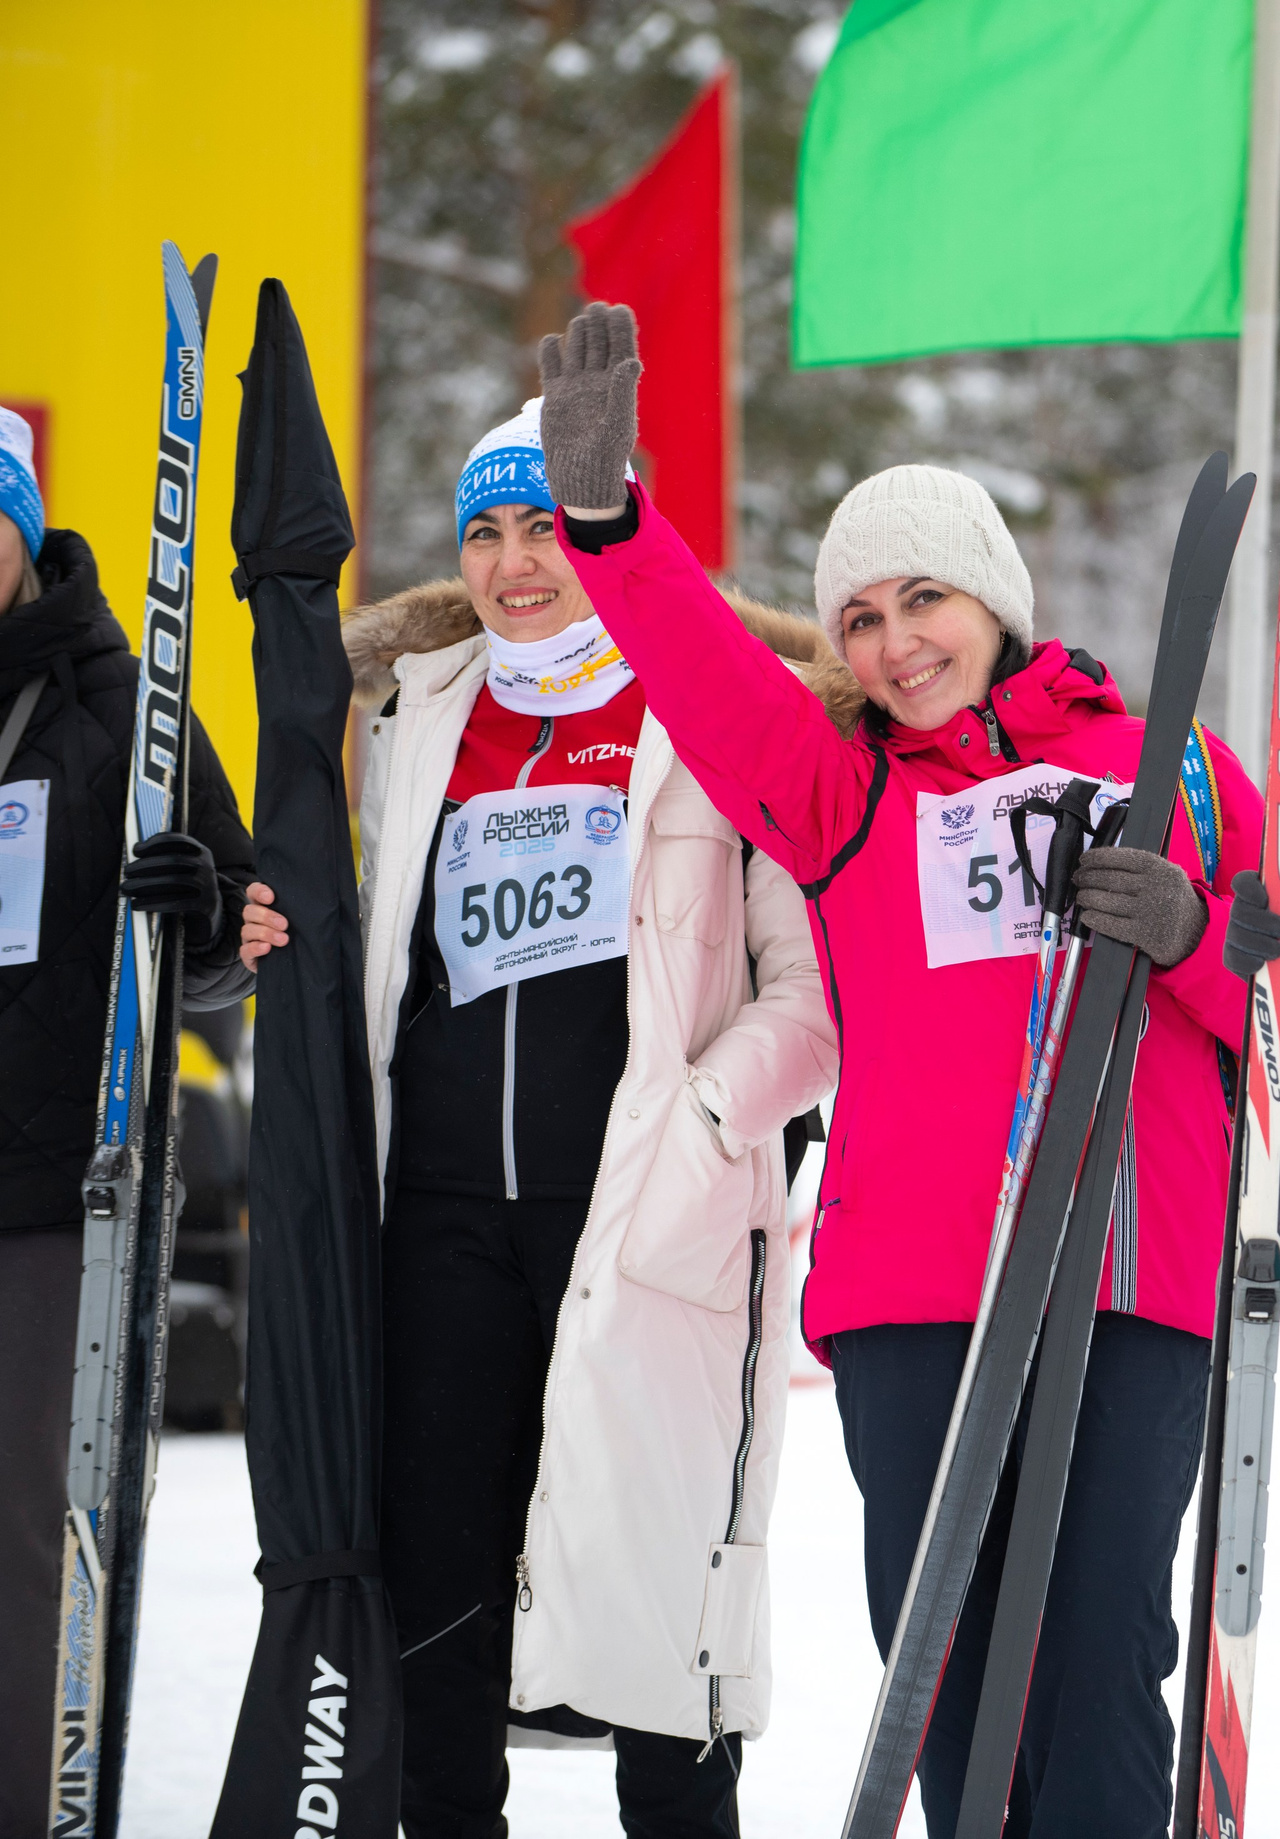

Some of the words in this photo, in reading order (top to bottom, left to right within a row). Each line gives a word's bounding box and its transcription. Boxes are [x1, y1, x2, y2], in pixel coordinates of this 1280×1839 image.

[179, 348, 196, 419] OMNI
[486, 803, 567, 828] ЛЫЖНЯ
[483, 819, 570, 845] РОССИИ
[939, 828, 979, 842] МИНСПОРТ
[944, 836, 974, 847] РОССИИ
[447, 851, 471, 867] МИНСПОРТ
[499, 837, 556, 858] 2025
[448, 861, 468, 873] РОССИИ
[967, 849, 1036, 913] 51
[461, 864, 593, 948] 5063
[112, 935, 124, 970] WOOD
[493, 949, 549, 972] АВТОНОМНЫЙ
[551, 943, 578, 956] ОКРУГ
[590, 936, 616, 948] ЮГРА
[495, 933, 579, 963] ХАНТЫ-МАНСИЙСКИЙ
[117, 1048, 128, 1085] AIRMIX
